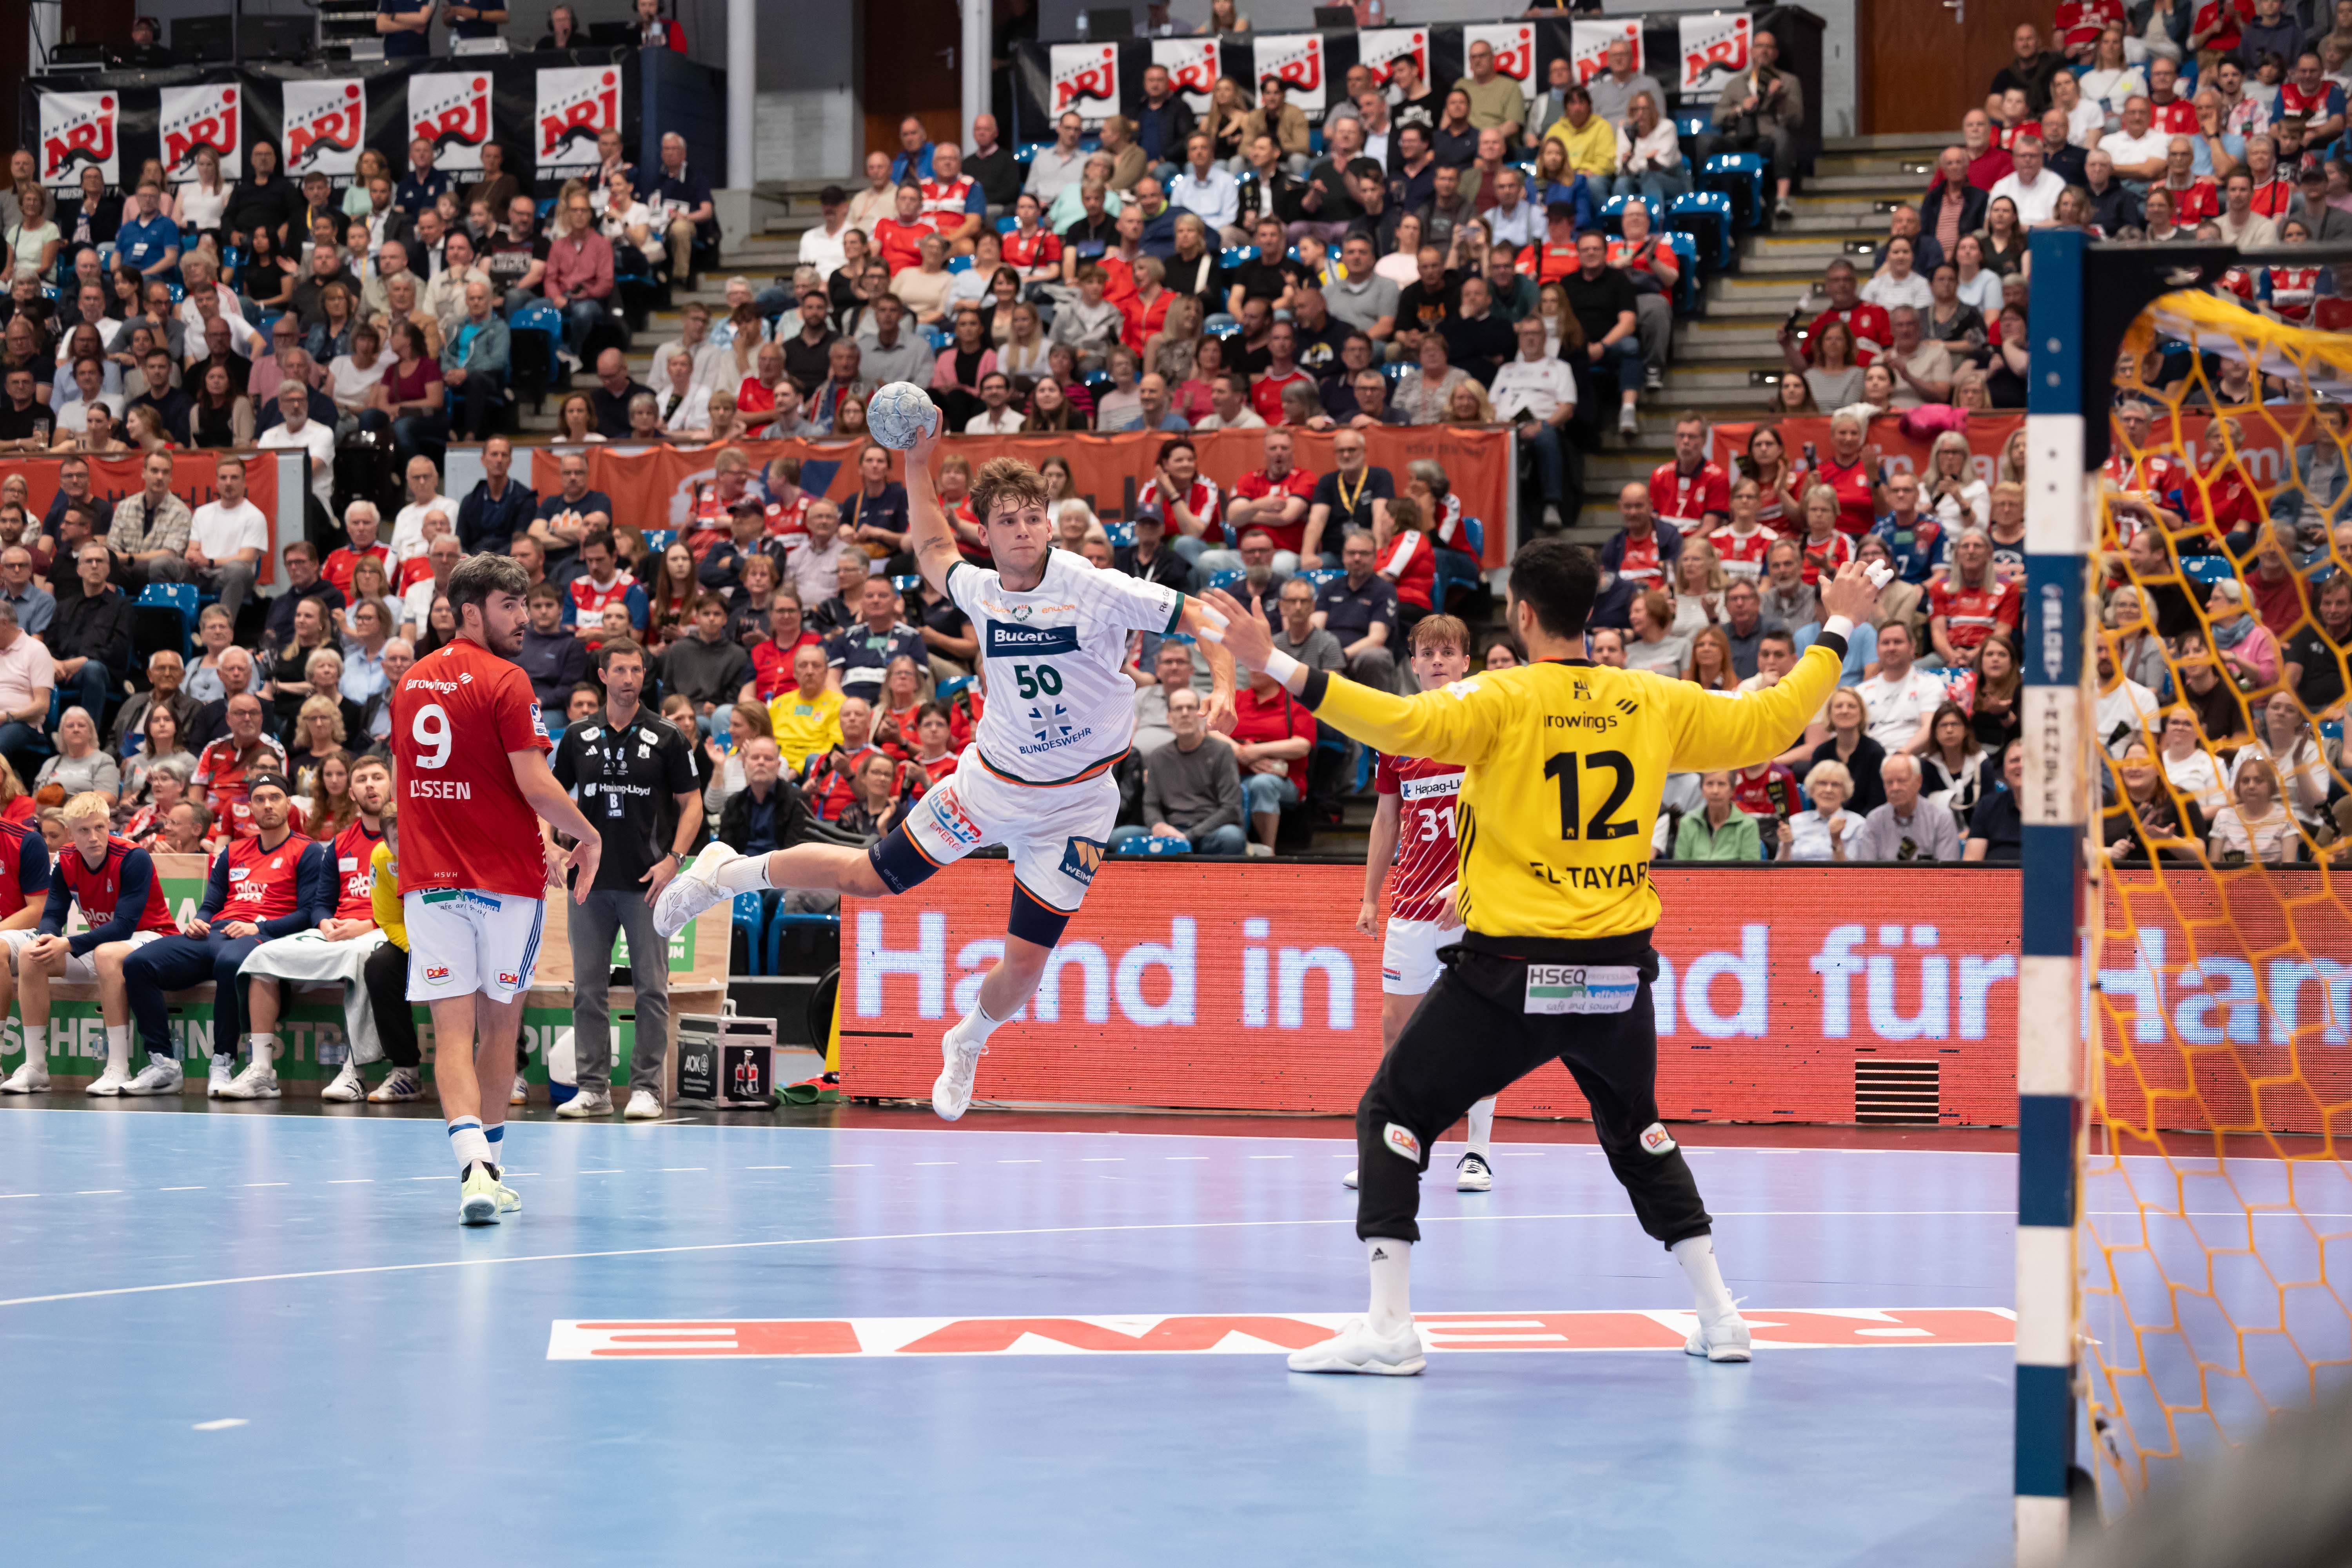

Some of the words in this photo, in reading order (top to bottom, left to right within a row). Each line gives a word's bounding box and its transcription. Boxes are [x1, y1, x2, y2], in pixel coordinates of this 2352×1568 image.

[1494, 28, 1531, 79] RJ
[1577, 25, 1638, 87] NJ
[1686, 18, 1747, 86] NRJ
[1056, 48, 1114, 111] NRJ
[44, 96, 114, 178] NRJ
[165, 88, 236, 173] NRJ
[288, 84, 361, 169] NRJ
[1896, 554, 1909, 575] 7
[405, 678, 458, 694] Eurowings
[1014, 664, 1063, 699] 50
[412, 704, 452, 769] 9
[1544, 711, 1618, 733] rowings
[1019, 728, 1092, 755] BUNDESWEHR
[610, 793, 619, 809] B
[1543, 750, 1639, 841] 12
[1418, 806, 1457, 841] 31
[347, 872, 370, 889] pla
[426, 966, 449, 978] Dole
[856, 911, 1197, 1026] Hand
[1243, 917, 1356, 1030] in
[1810, 924, 2016, 1040] für
[1530, 968, 1586, 986] HSEQ
[1589, 1000, 1621, 1011] sound
[684, 1054, 701, 1073] AOK
